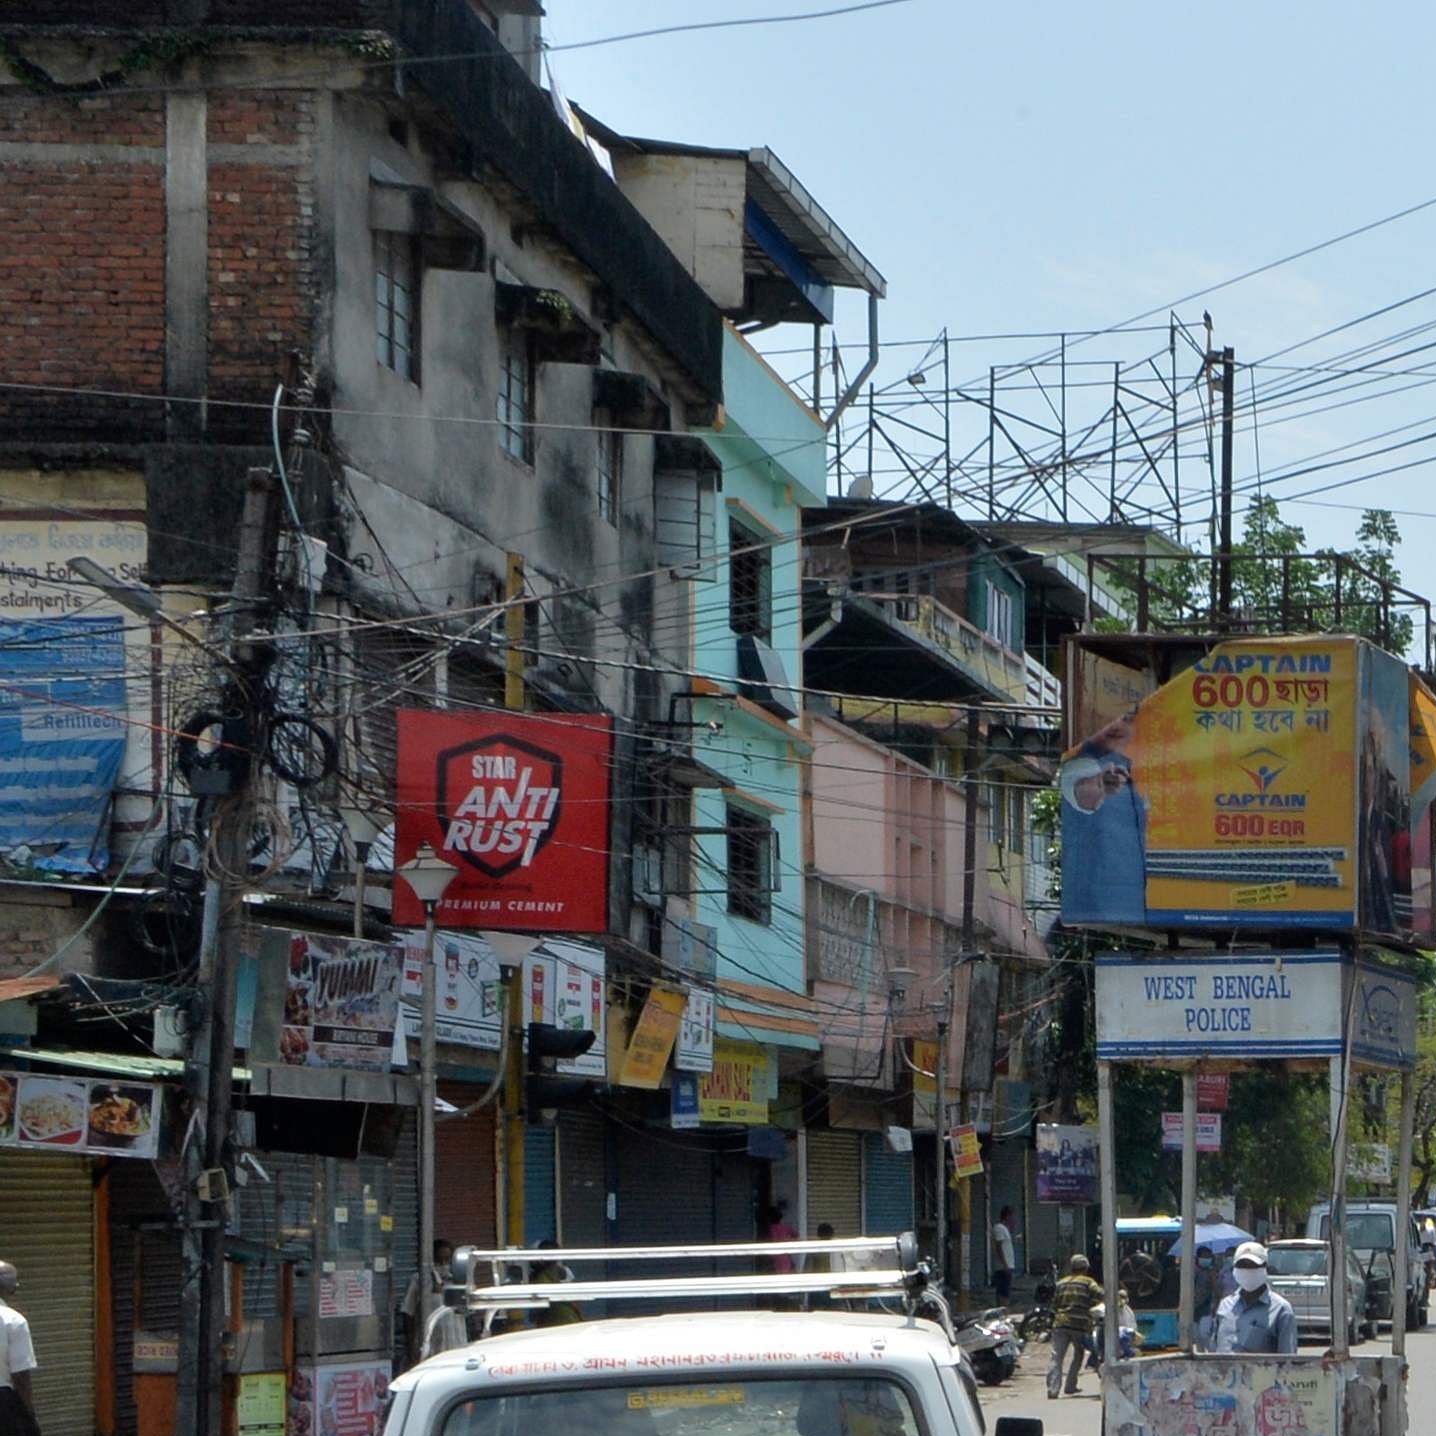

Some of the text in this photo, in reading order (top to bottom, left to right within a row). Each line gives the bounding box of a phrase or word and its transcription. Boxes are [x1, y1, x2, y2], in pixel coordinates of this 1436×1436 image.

[1192, 674, 1328, 708] 600 ছাড়া
[1194, 709, 1329, 733] কথা হবে না
[472, 754, 516, 780] STAR
[454, 766, 561, 820] ANTI
[1215, 793, 1306, 807] CAPTAIN
[1215, 813, 1305, 837] 600 EQR
[443, 819, 550, 868] RUST
[435, 899, 565, 912] PREMIUM CEMENT
[1144, 974, 1292, 1000] WEST BENGAL
[1185, 1006, 1252, 1032] POLICE
